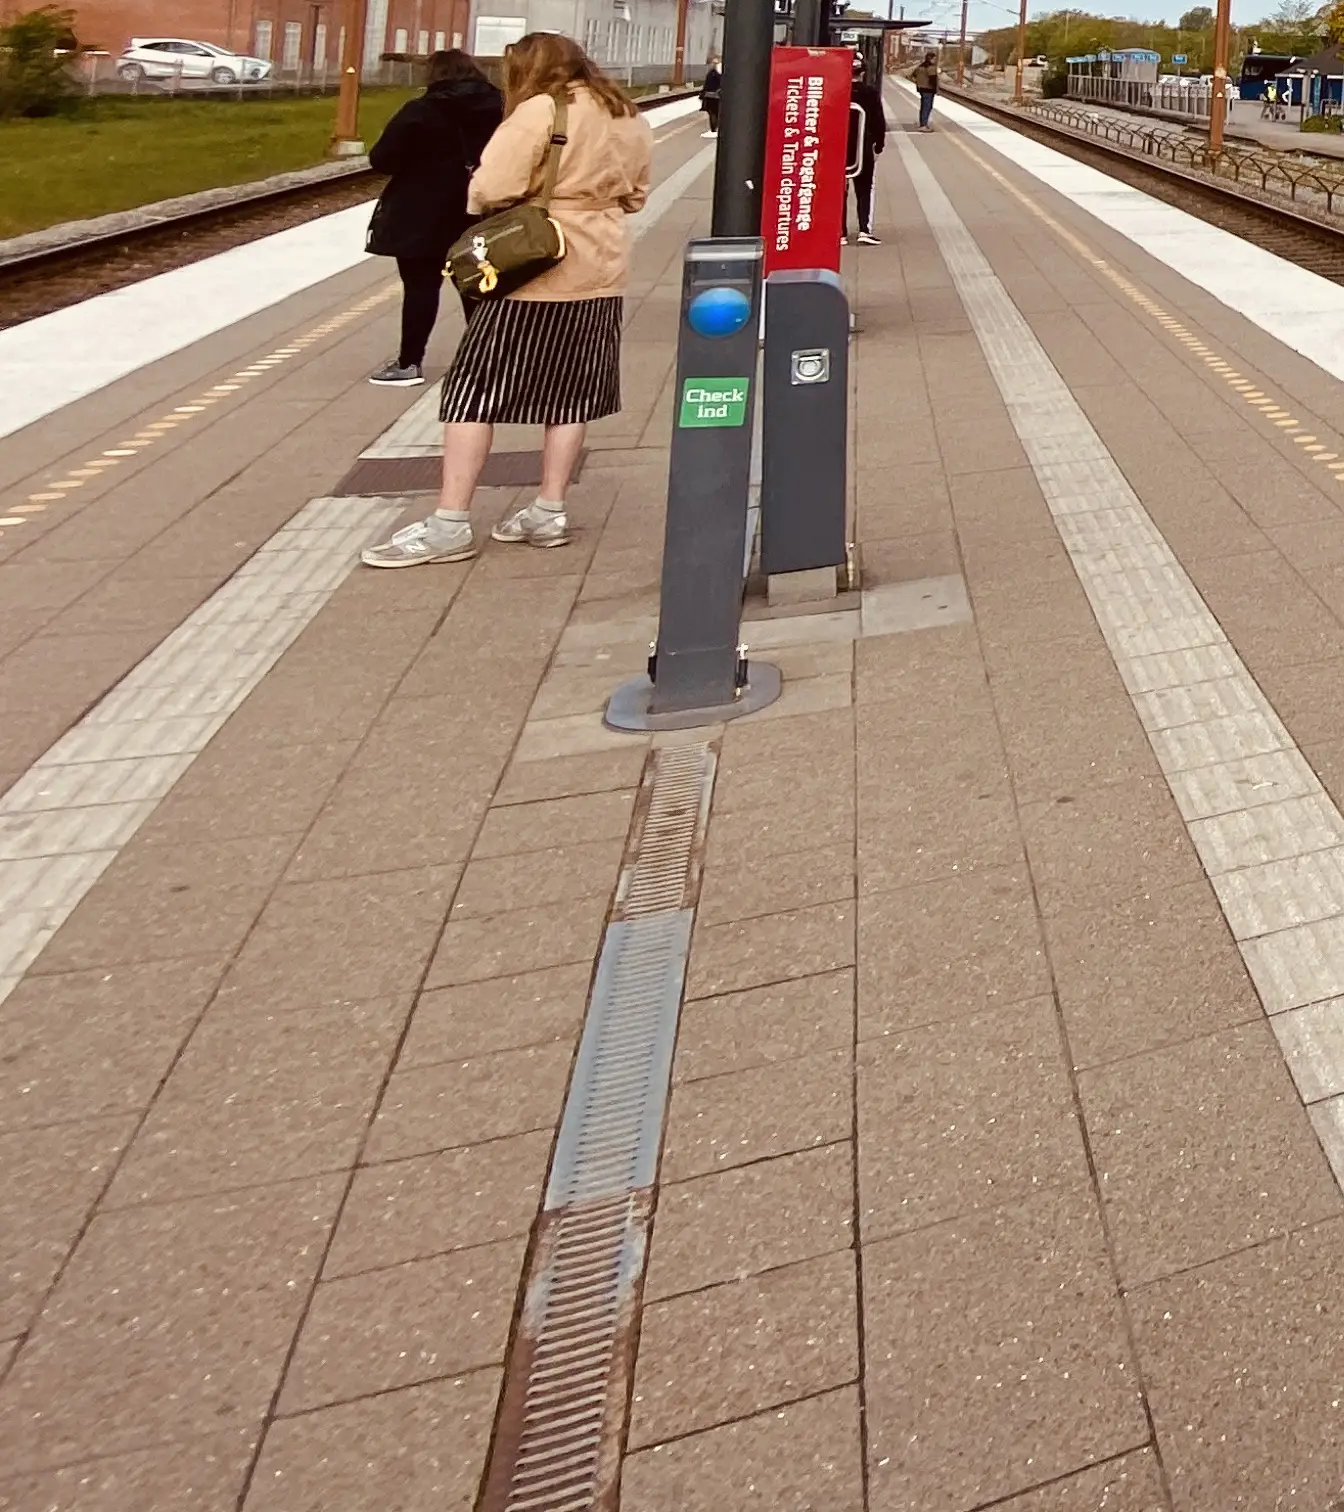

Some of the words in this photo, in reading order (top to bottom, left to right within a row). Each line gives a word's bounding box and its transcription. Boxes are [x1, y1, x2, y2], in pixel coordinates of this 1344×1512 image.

[784, 76, 804, 124] Tickets
[804, 76, 824, 134] Billetter
[784, 127, 801, 138] &
[803, 135, 820, 147] &
[781, 141, 799, 175] Train
[796, 149, 819, 231] Togafgange
[776, 178, 797, 251] departures
[685, 388, 745, 403] Check
[697, 404, 728, 418] ind
